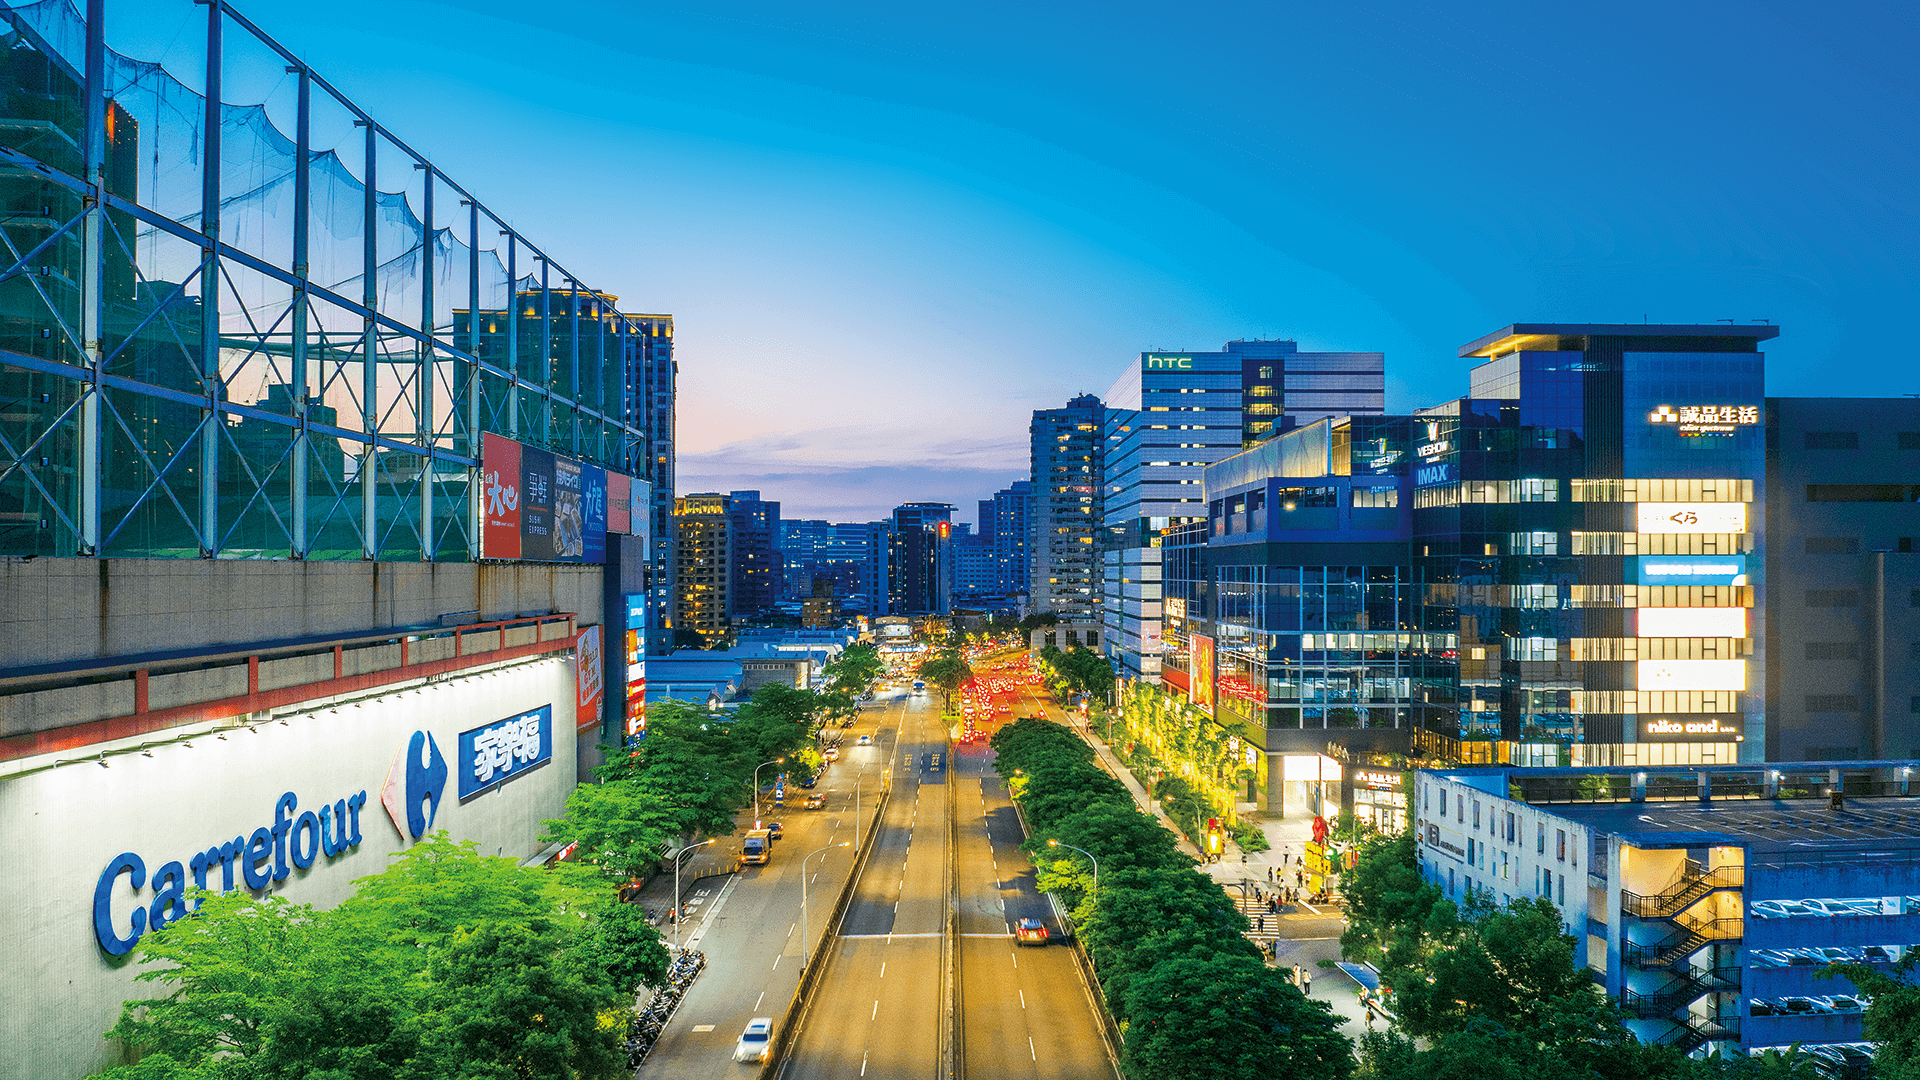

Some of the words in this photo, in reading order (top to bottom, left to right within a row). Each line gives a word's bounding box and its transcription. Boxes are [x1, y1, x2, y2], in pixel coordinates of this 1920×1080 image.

[1679, 405, 1758, 424] 誠品生活
[1417, 464, 1449, 486] IMAX
[1669, 511, 1698, 525] くら
[1646, 719, 1684, 734] niko
[1685, 719, 1719, 734] and
[474, 714, 540, 782] 家樂福
[93, 789, 367, 956] Carrefour
